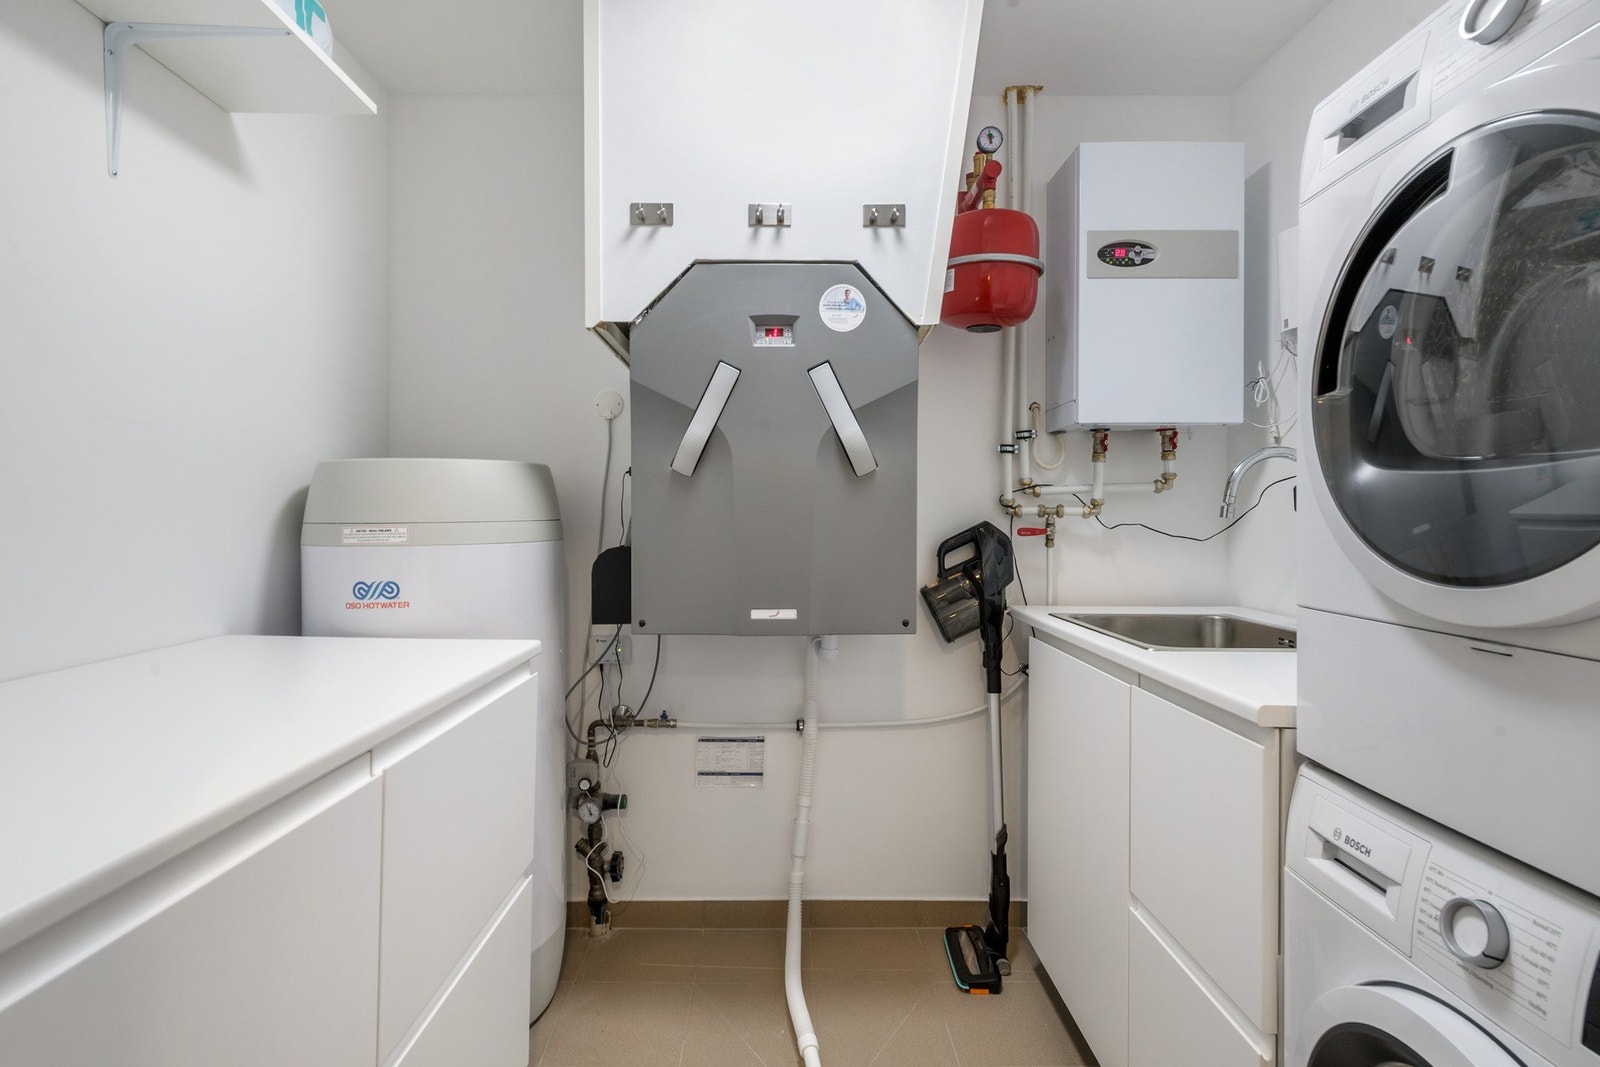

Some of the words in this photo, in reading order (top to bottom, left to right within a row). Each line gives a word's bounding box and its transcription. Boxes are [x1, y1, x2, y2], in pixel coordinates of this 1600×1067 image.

[1114, 249, 1126, 257] 29
[345, 602, 362, 610] OSO
[362, 601, 410, 609] HOTWATER
[1344, 835, 1372, 858] BOSCH
